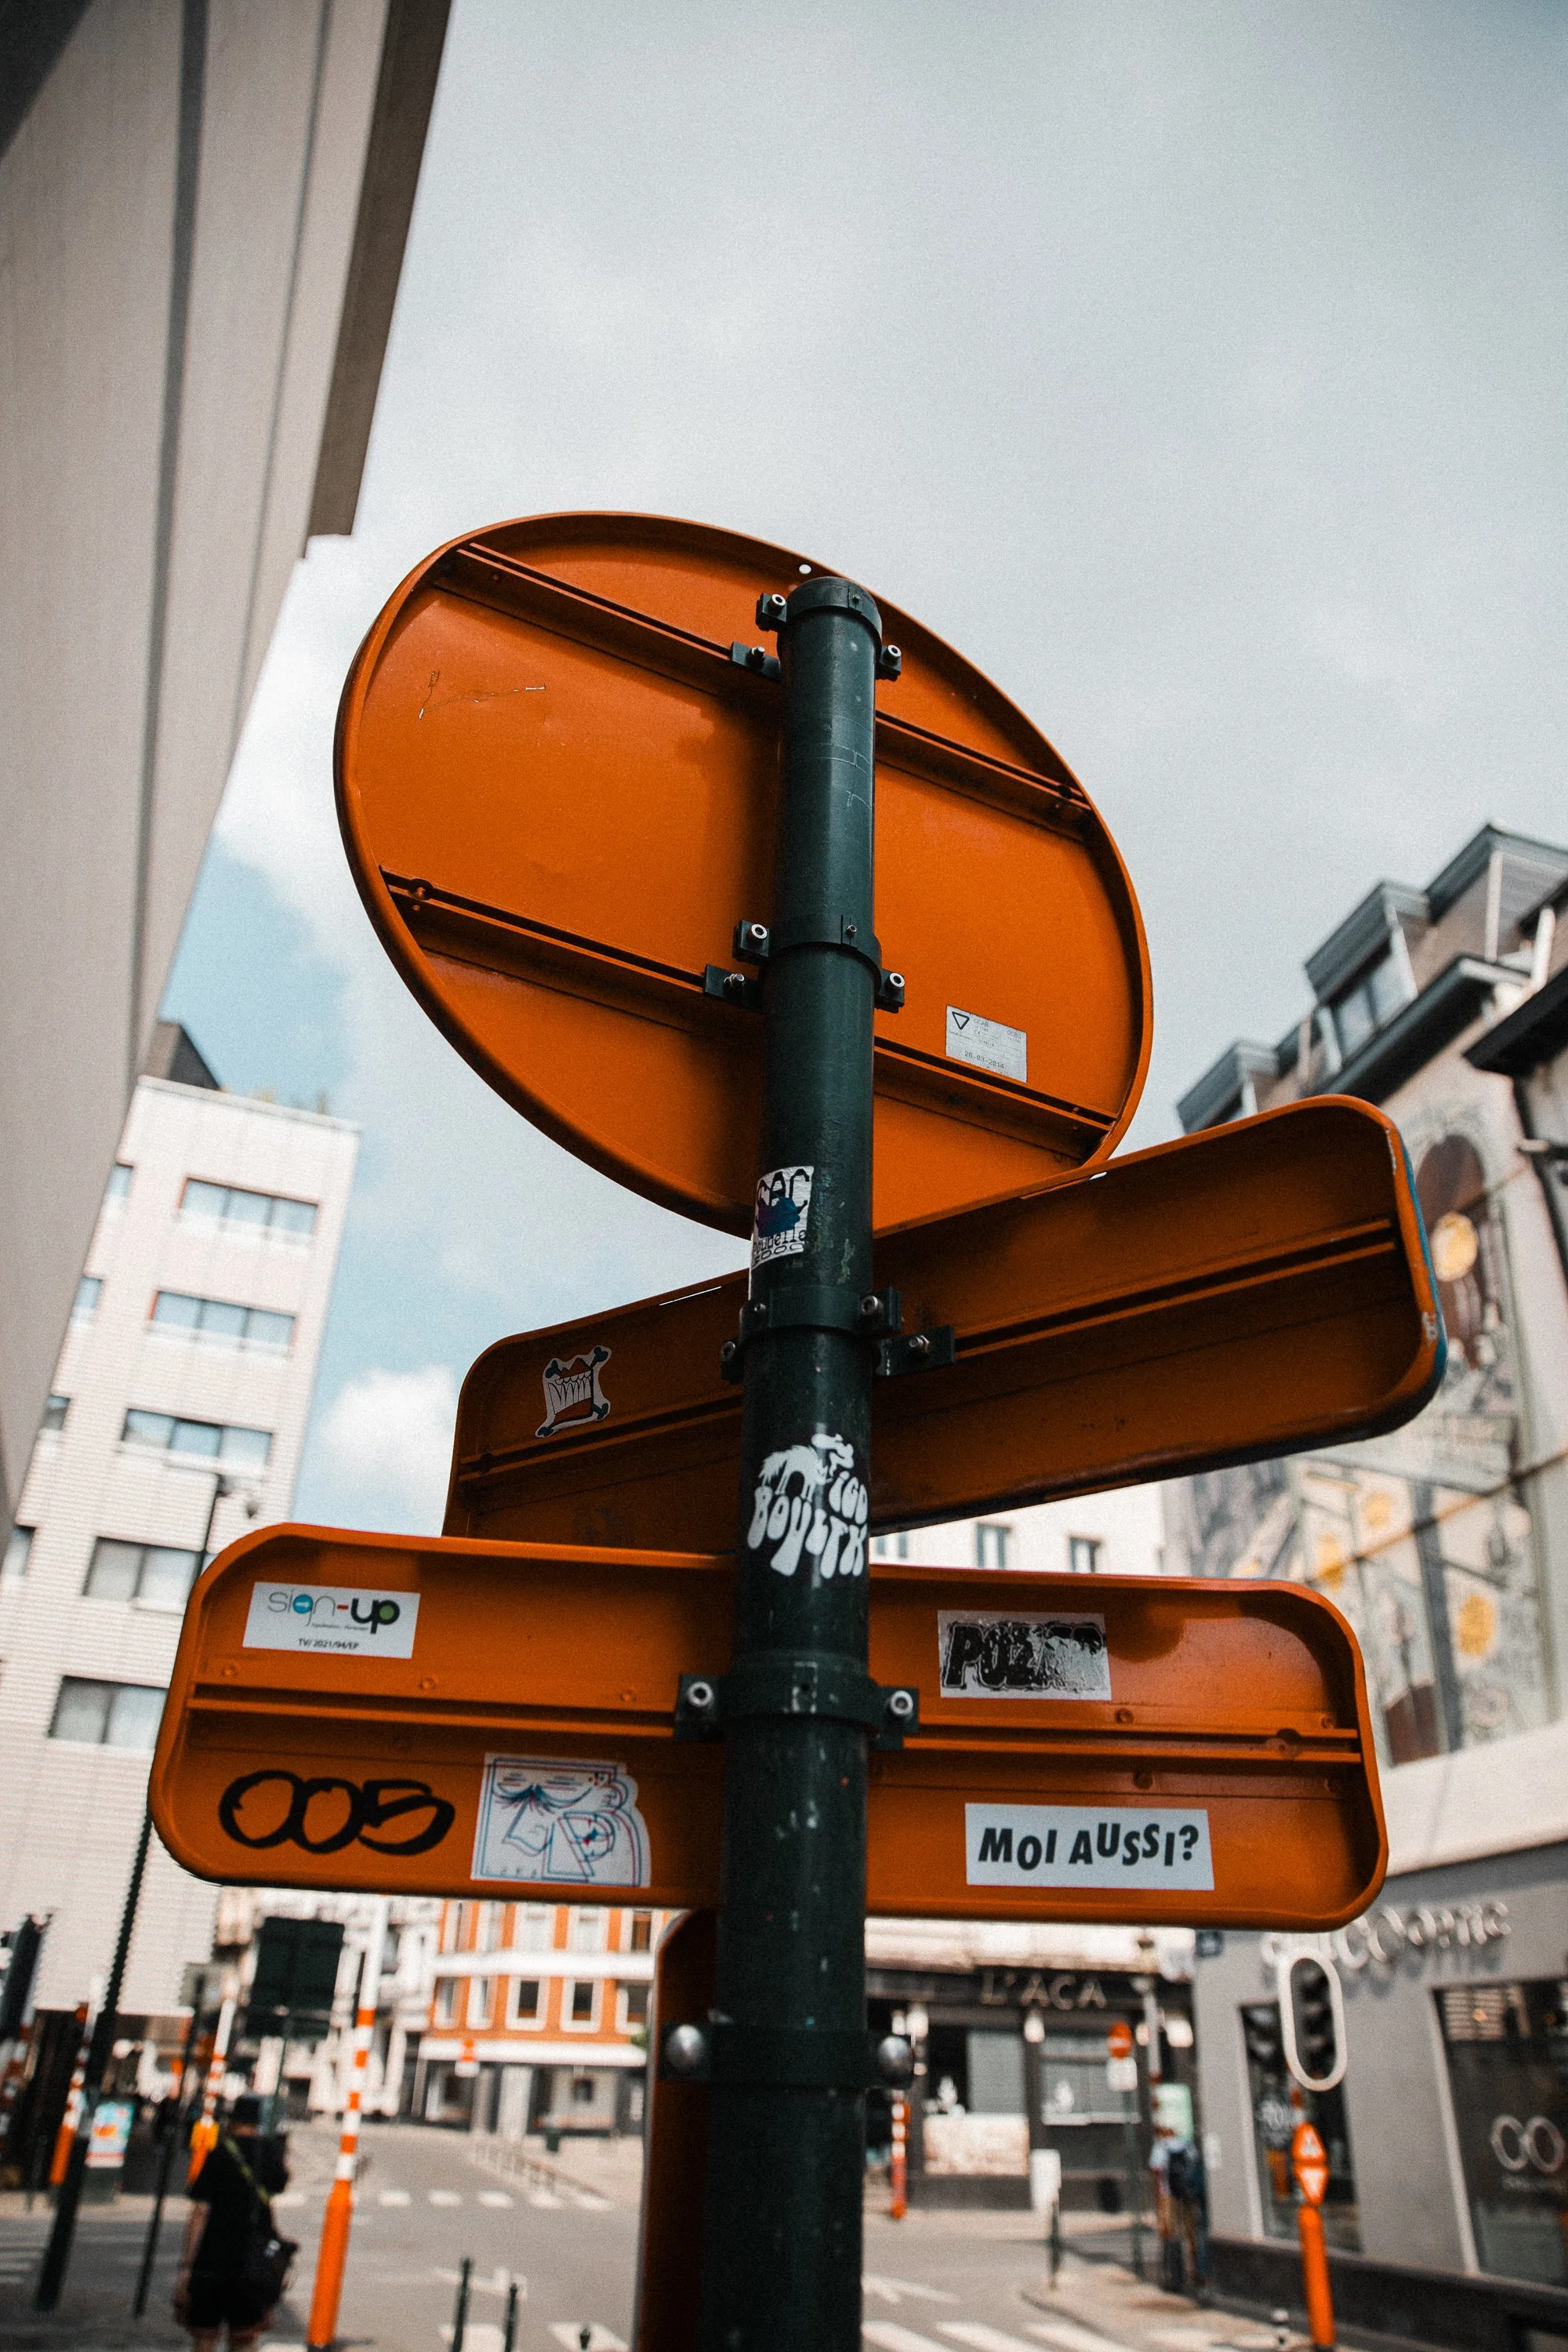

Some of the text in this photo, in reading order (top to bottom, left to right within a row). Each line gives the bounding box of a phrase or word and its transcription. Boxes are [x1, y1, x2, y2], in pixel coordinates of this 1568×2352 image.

[964, 1051, 1005, 1069] 26-03-2014
[267, 1591, 401, 1635] sign-up
[978, 1823, 1200, 1871] MOI AUSSI?
